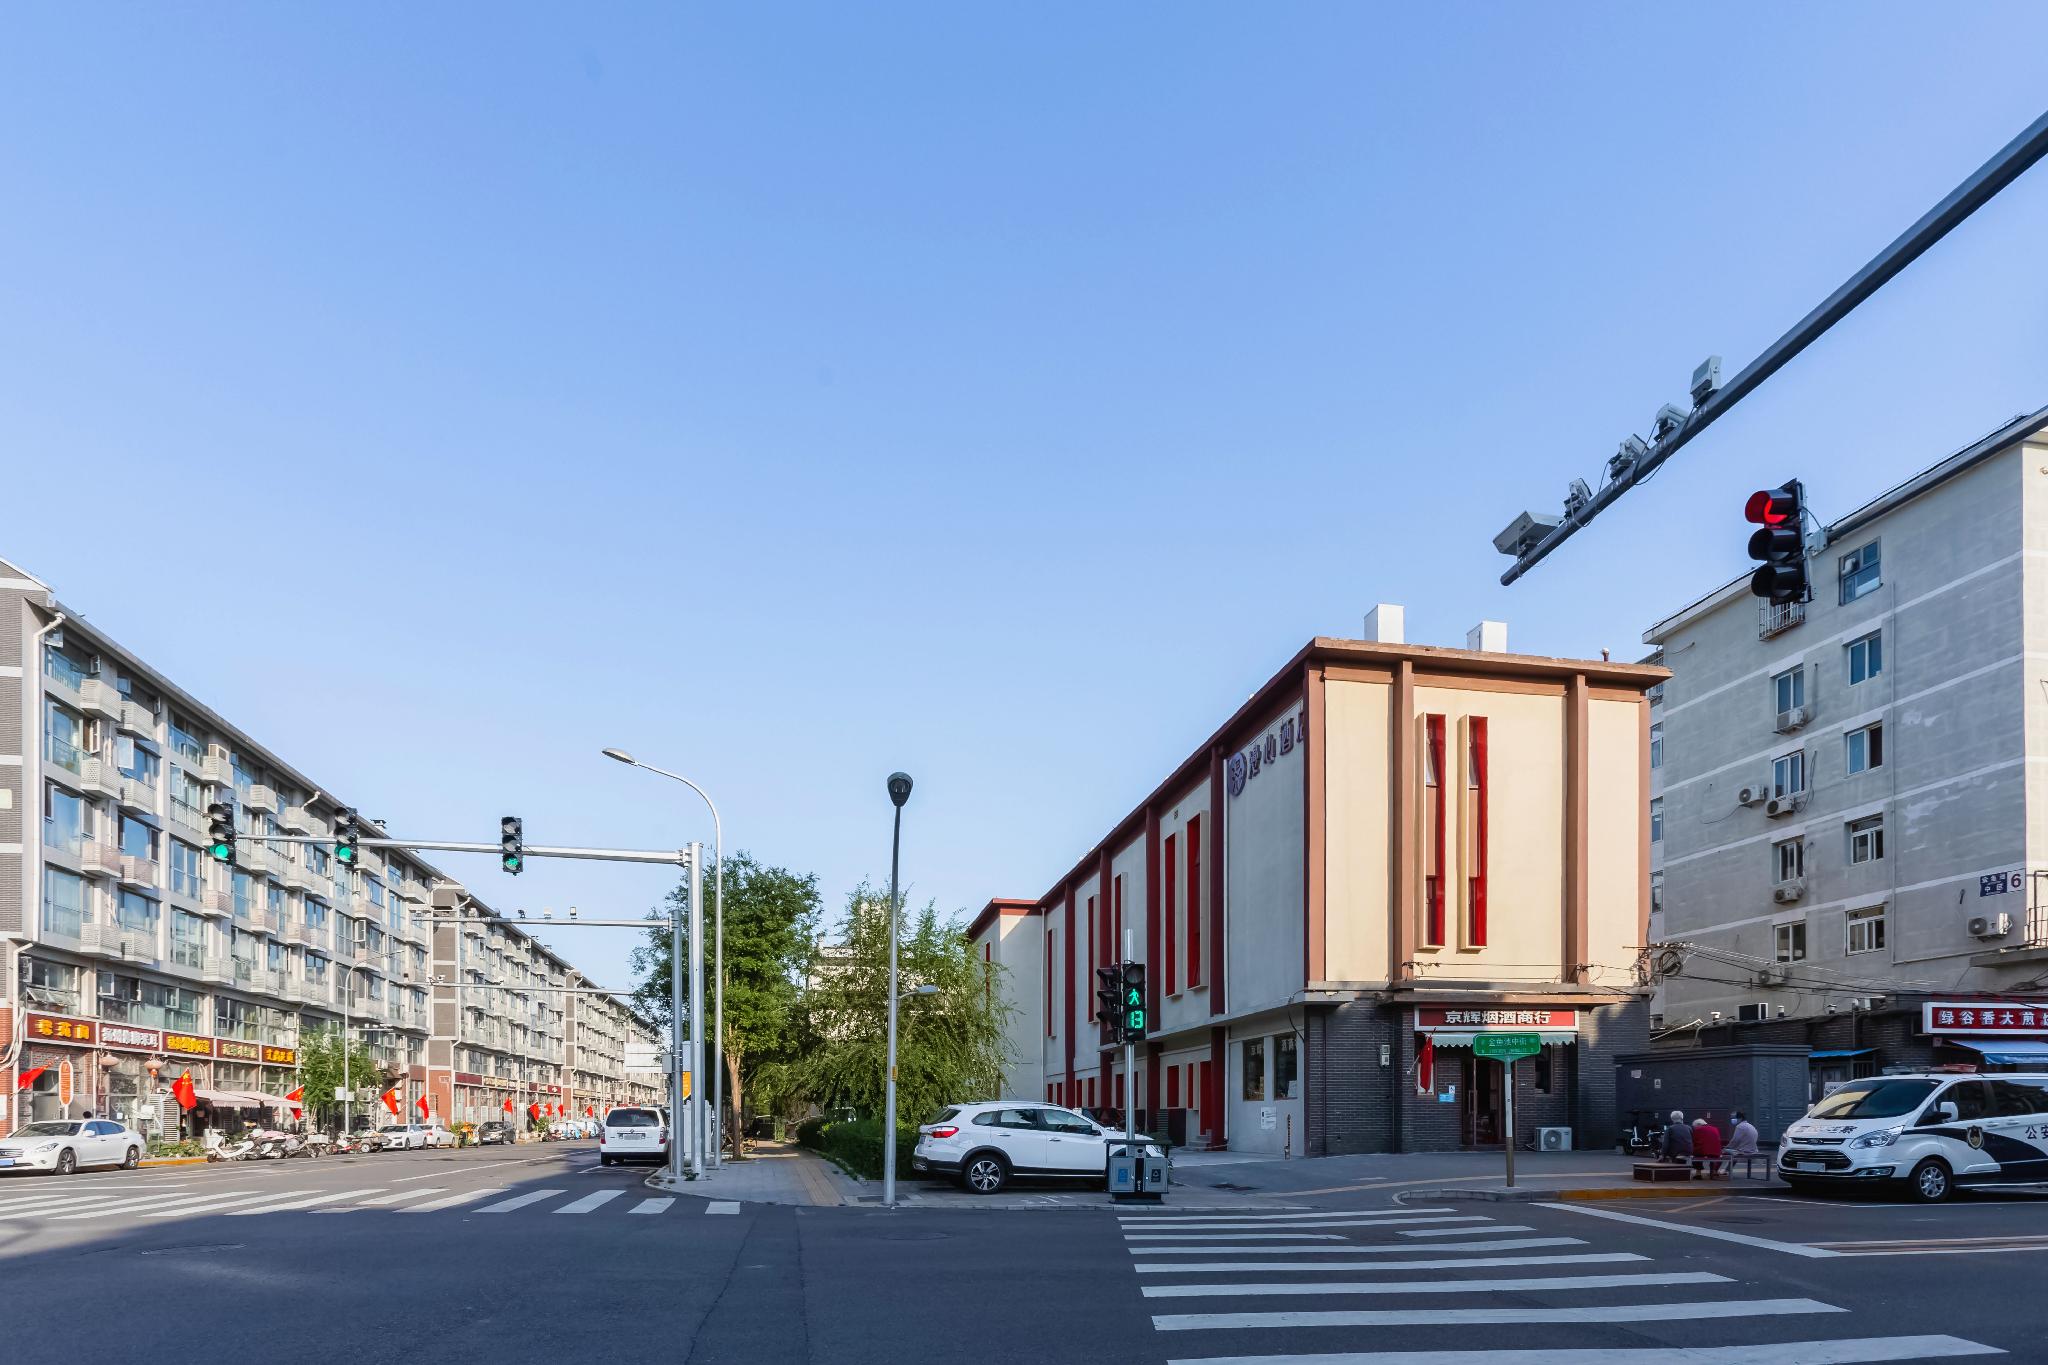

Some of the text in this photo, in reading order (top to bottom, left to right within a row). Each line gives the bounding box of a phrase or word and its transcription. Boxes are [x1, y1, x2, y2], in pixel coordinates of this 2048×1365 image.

[2011, 873, 2021, 888] 6
[1131, 1010, 1144, 1029] 13
[1445, 1010, 1551, 1024] 京辉烟酒商行
[2025, 1125, 2048, 1140] 公安
